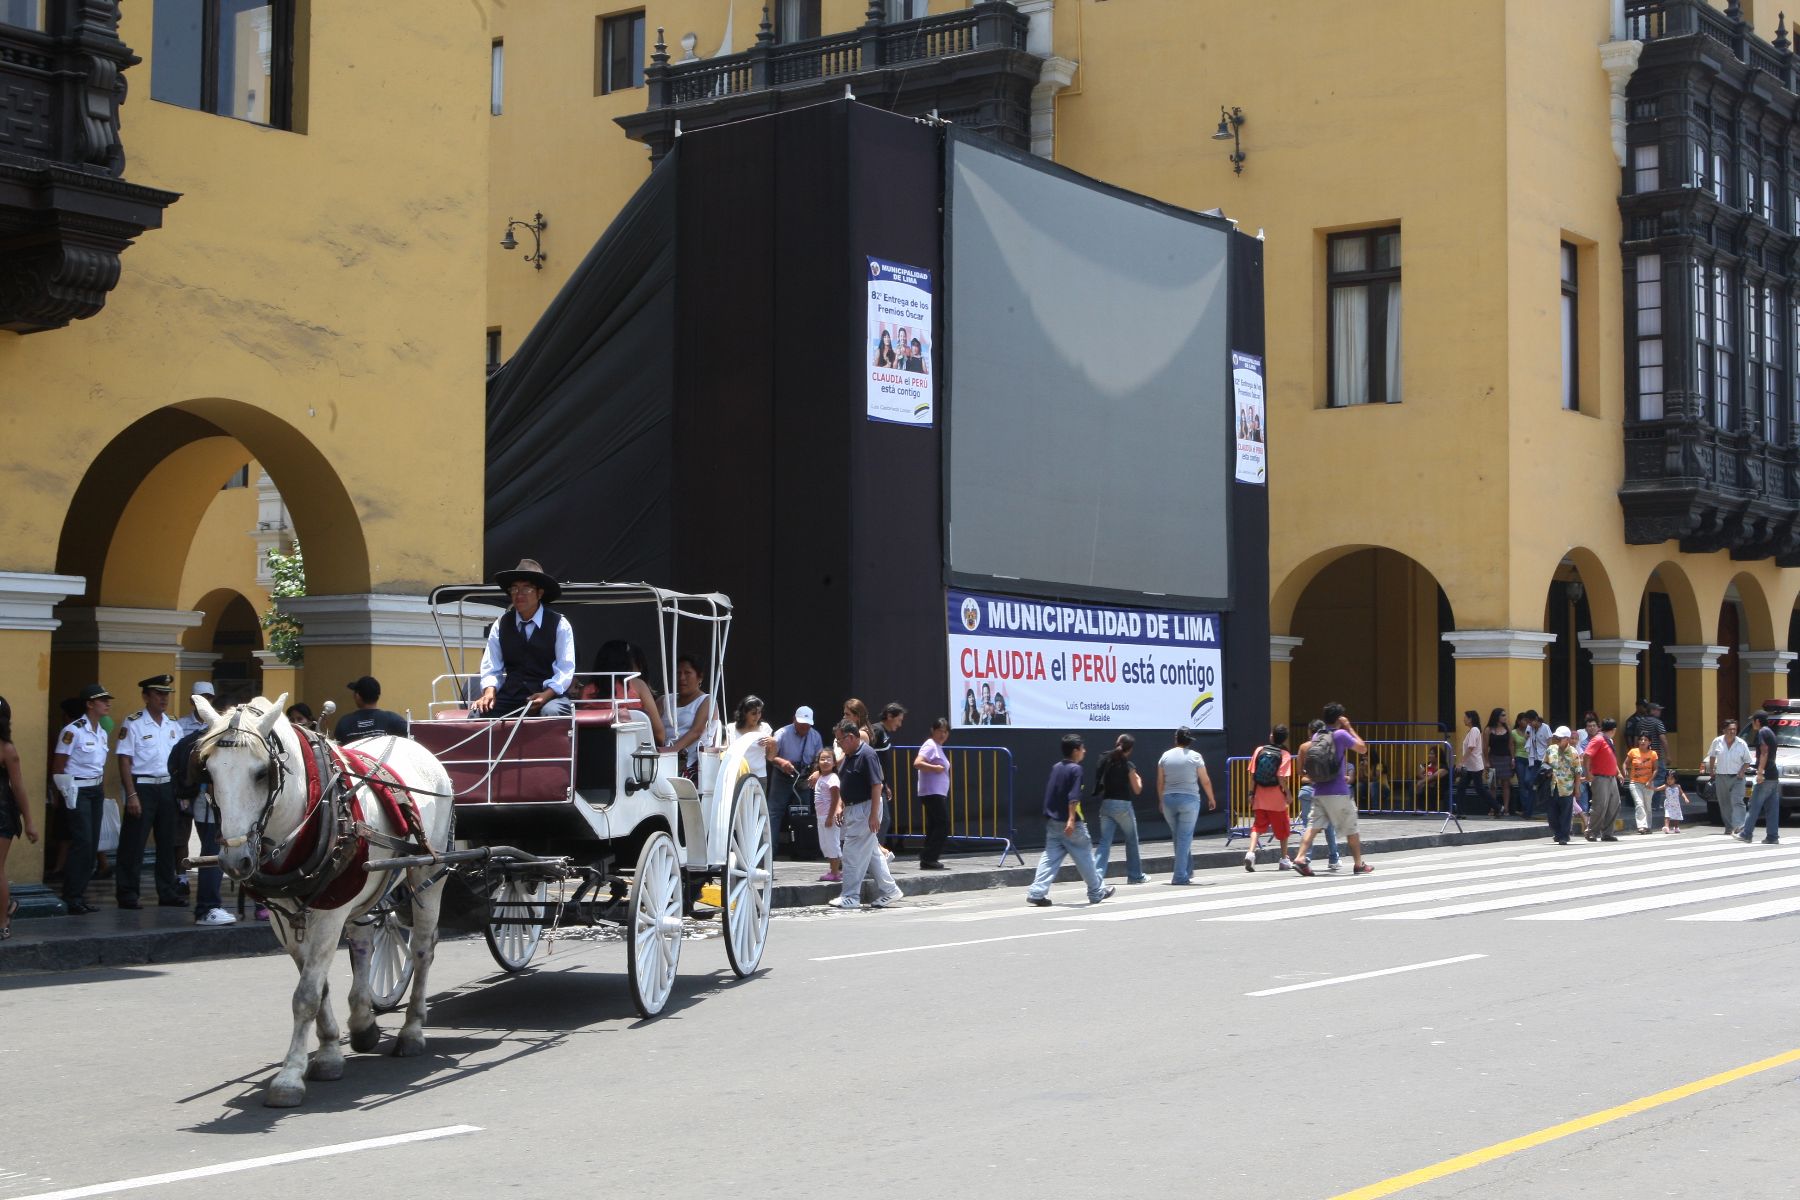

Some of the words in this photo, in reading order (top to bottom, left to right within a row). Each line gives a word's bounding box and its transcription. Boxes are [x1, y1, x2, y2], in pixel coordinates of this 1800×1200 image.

[881, 264, 928, 280] MUNICIPALIDAD
[902, 275, 918, 285] LIMA
[883, 293, 909, 307] Entrega
[910, 299, 919, 308] de
[919, 300, 929, 310] los
[878, 304, 905, 317] Premios
[872, 372, 903, 384] CLAUDIA
[904, 376, 911, 386] el
[911, 377, 928, 389] PERÚ
[880, 384, 896, 394] está
[897, 387, 921, 399] contigo
[987, 601, 1142, 638] MUNICIPALIDAD
[1146, 614, 1170, 640] DE
[1174, 615, 1216, 643] LIMA
[960, 647, 1047, 681] CLAUDIA
[1051, 651, 1067, 682] el
[1072, 645, 1117, 684] PERÚ
[1121, 653, 1156, 684] está
[1159, 657, 1215, 693] contigo
[1065, 701, 1079, 711] Luis
[1079, 701, 1111, 712] Castañeda
[1111, 702, 1130, 712] Lossio
[1089, 713, 1111, 723] Alcalde
